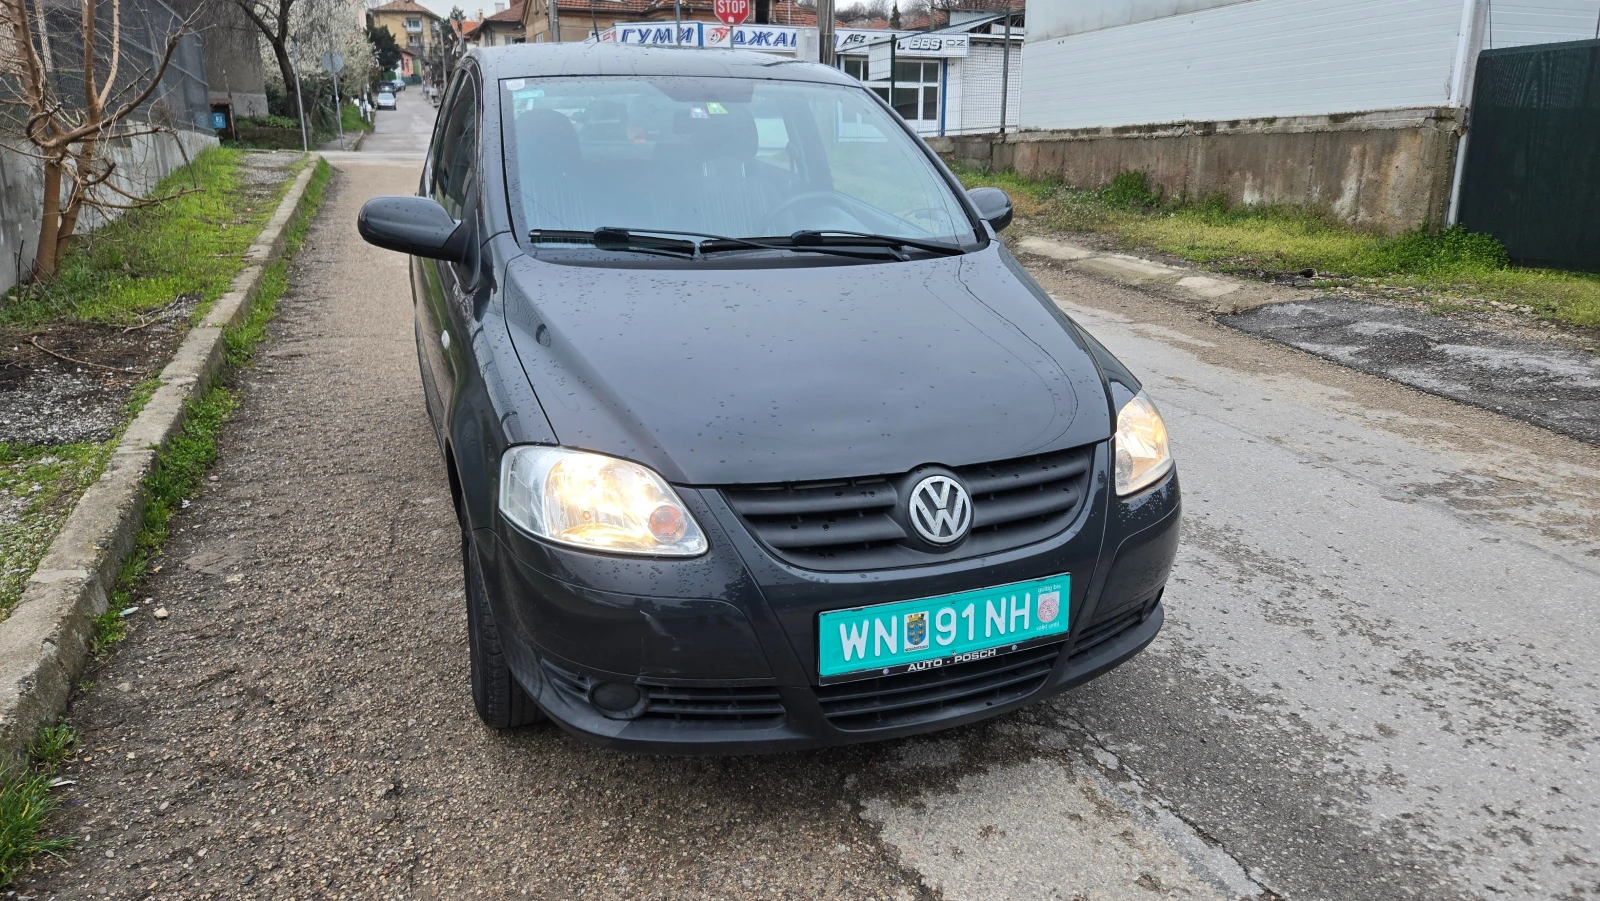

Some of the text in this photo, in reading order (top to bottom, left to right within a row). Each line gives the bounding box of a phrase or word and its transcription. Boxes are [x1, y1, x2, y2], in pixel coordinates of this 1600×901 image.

[718, 0, 746, 14] STOP
[621, 27, 694, 44] ГУМИ
[840, 34, 867, 48] AEZ
[909, 38, 943, 51] BBS
[945, 39, 966, 47] OZ
[839, 615, 898, 662] WN
[907, 659, 943, 672] AUTO
[954, 648, 997, 664] POSCH
